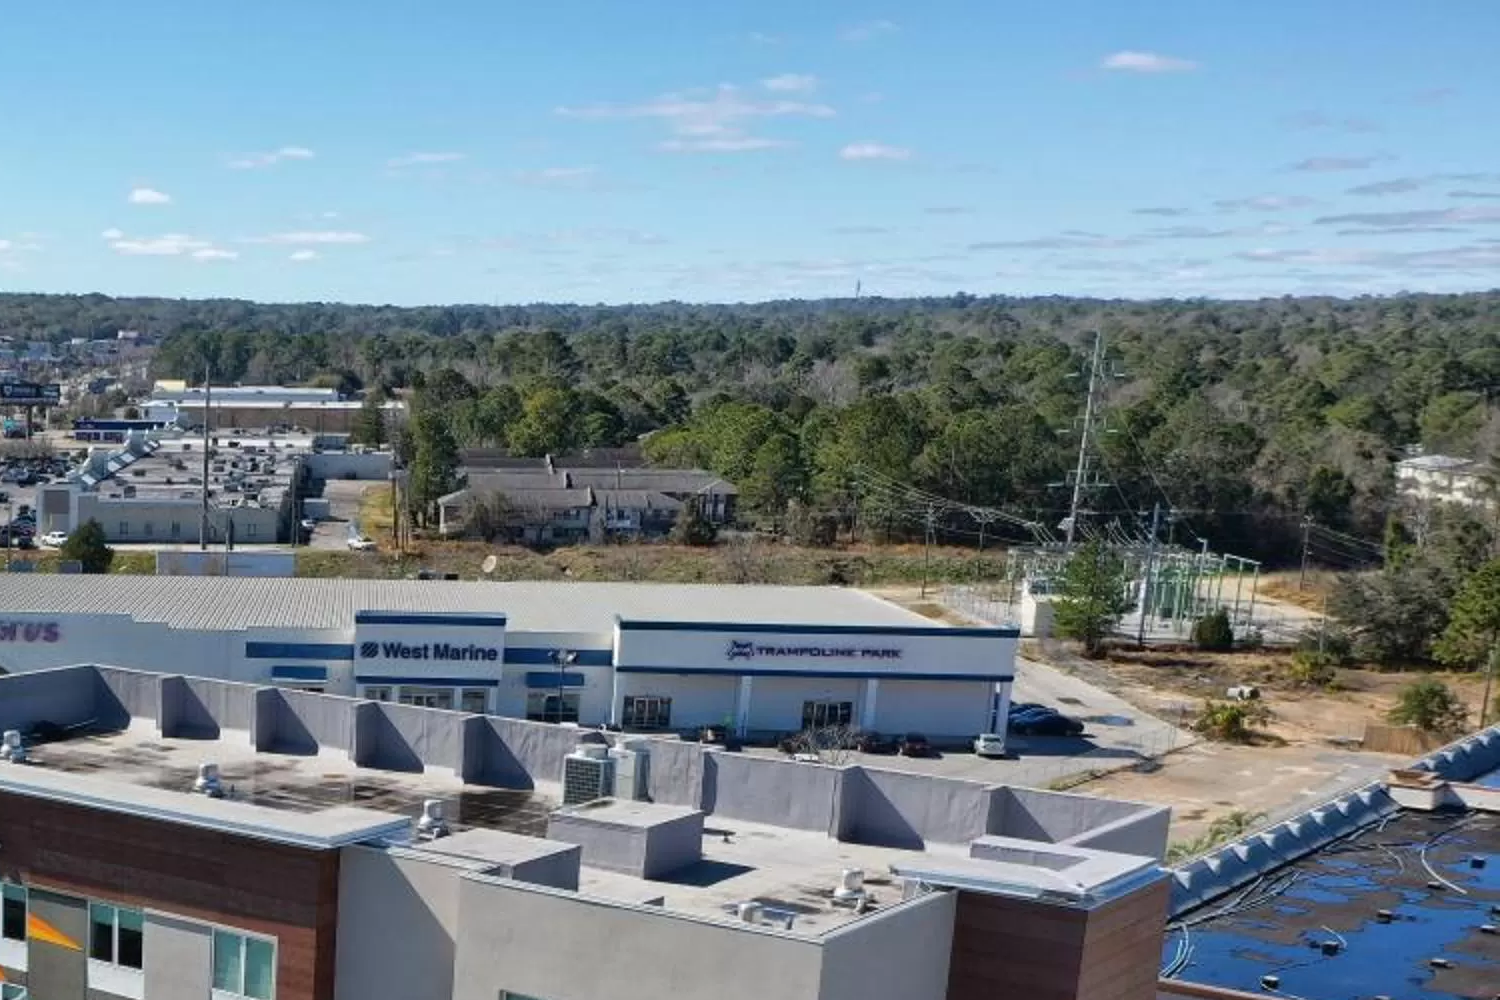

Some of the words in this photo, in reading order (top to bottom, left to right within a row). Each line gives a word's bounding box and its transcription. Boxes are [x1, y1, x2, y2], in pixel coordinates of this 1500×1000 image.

[382, 642, 430, 660] West
[433, 643, 498, 661] Marine
[755, 646, 857, 658] TRAMPOLINE
[860, 649, 904, 660] PARK
